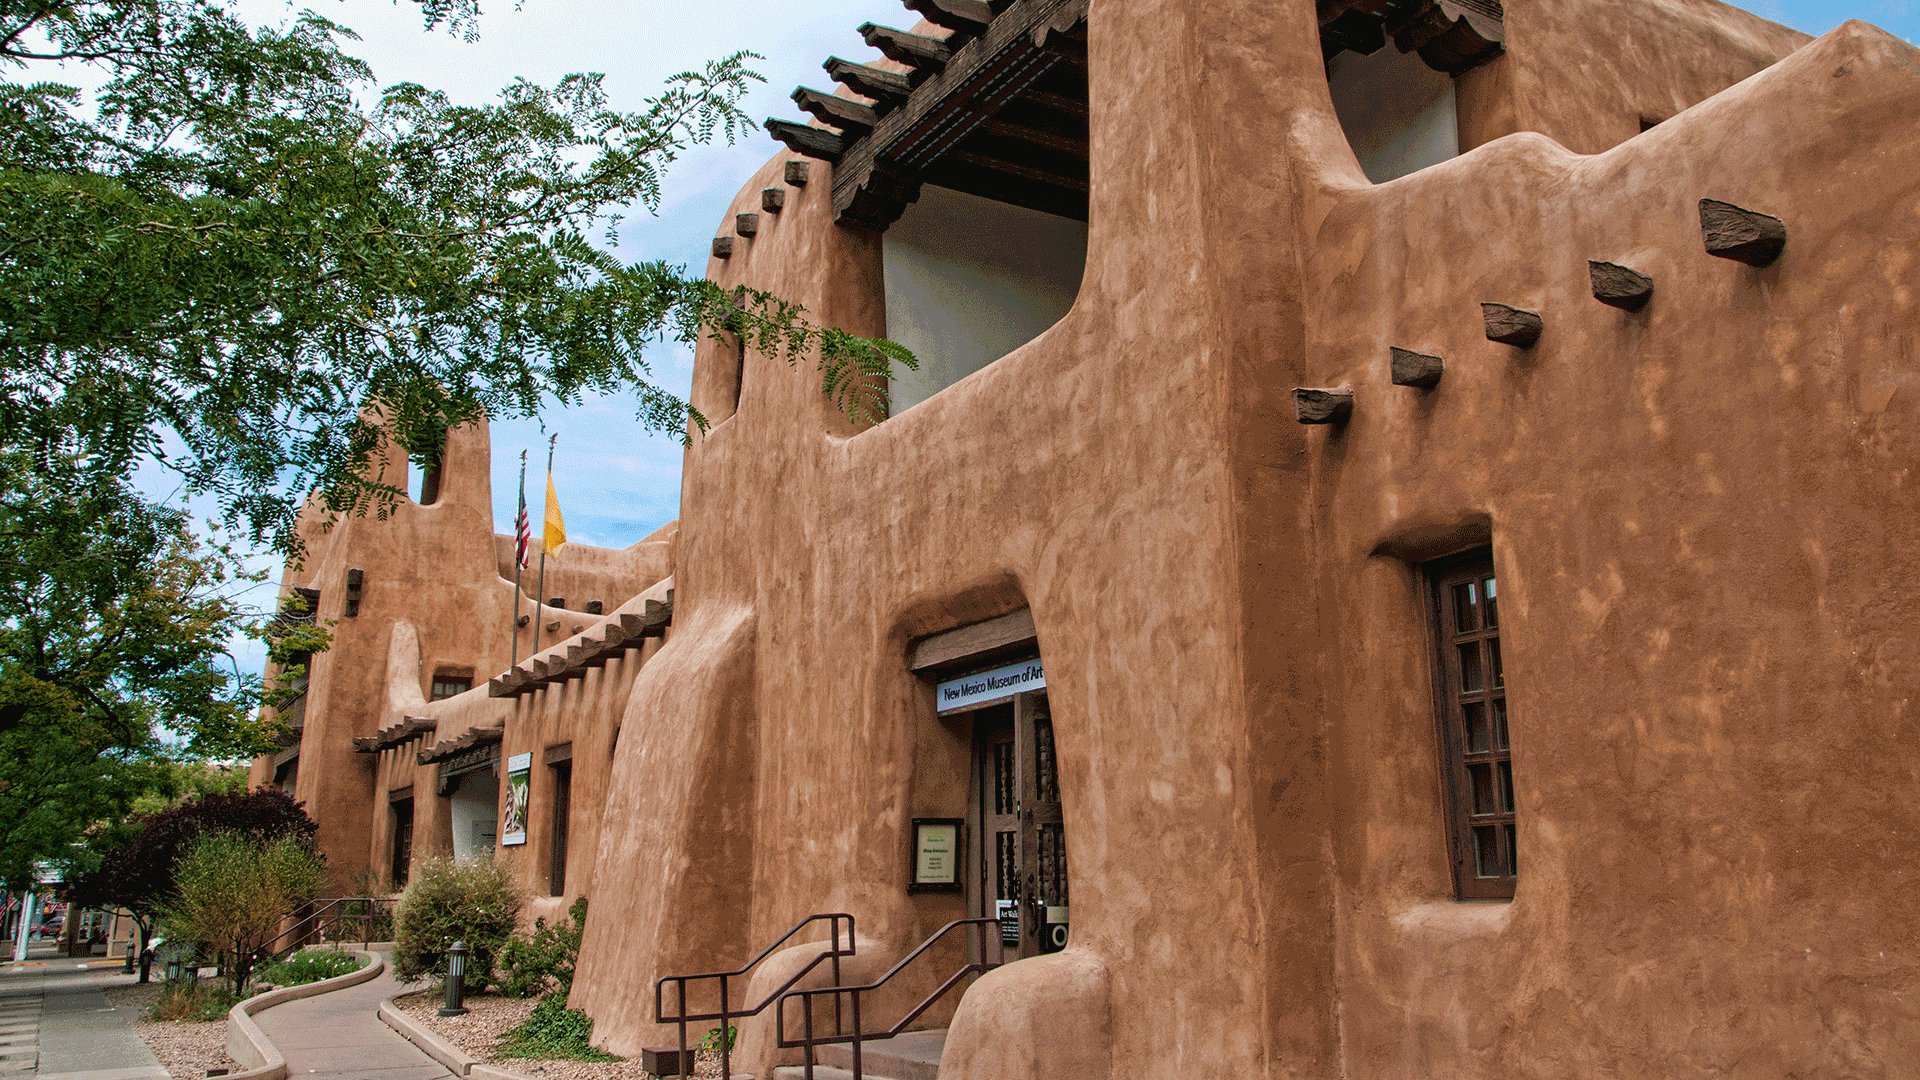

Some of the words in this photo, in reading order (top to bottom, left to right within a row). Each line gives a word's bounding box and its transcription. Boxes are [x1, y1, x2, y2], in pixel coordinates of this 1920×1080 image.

[944, 687, 959, 701] New
[961, 681, 986, 697] Mexico
[987, 673, 1020, 691] Museum
[1021, 667, 1030, 682] of
[1030, 665, 1043, 680] Art
